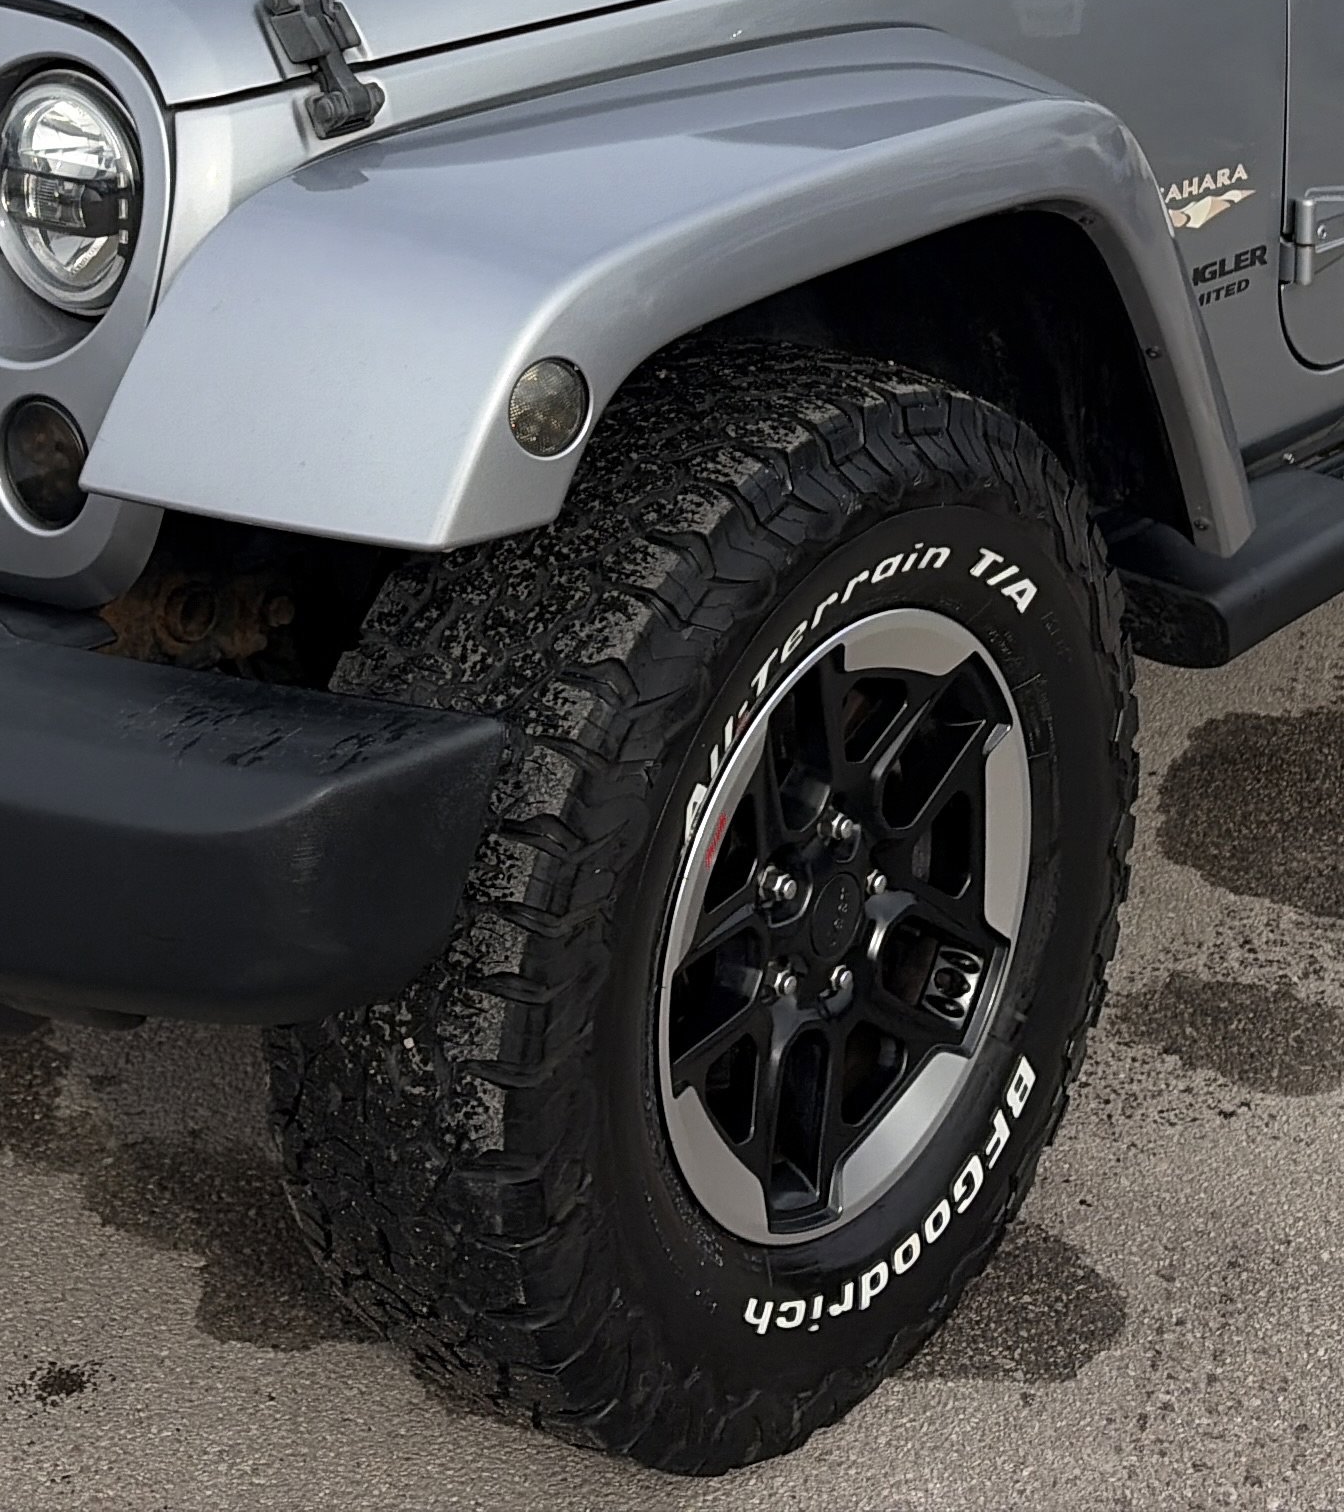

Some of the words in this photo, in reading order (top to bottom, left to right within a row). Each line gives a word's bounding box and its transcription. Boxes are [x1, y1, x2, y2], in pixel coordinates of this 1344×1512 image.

[1159, 163, 1248, 203] AHARA
[969, 548, 1039, 614] T/A
[744, 1055, 1036, 1335] BFGoodrich
